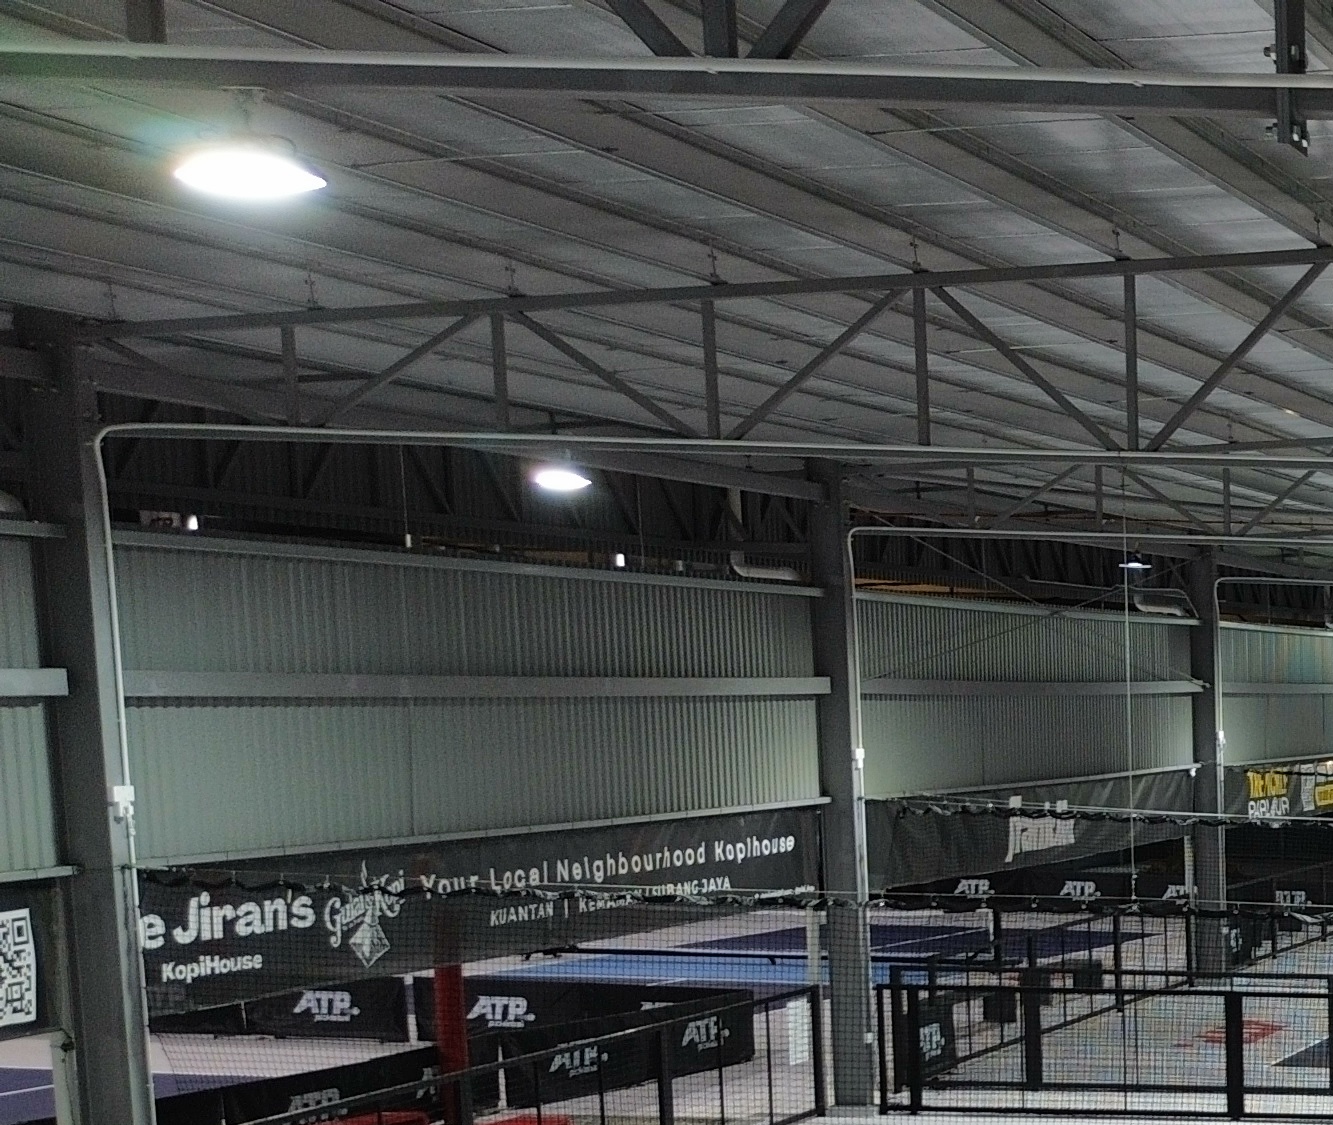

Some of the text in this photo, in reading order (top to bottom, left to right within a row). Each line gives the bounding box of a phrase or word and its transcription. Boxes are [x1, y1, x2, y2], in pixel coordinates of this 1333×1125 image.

[489, 860, 548, 891] Local
[557, 841, 706, 883] Neighbourhood
[714, 835, 795, 864] Kopihouse
[954, 879, 990, 895] ATP
[1059, 881, 1098, 898] ATP
[490, 901, 554, 927] KUANTAN
[701, 876, 731, 892] JAYA
[139, 888, 316, 950] e Jiran's
[161, 953, 263, 983] KopiHouse
[293, 990, 354, 1015] ATP
[466, 995, 528, 1021] ATP
